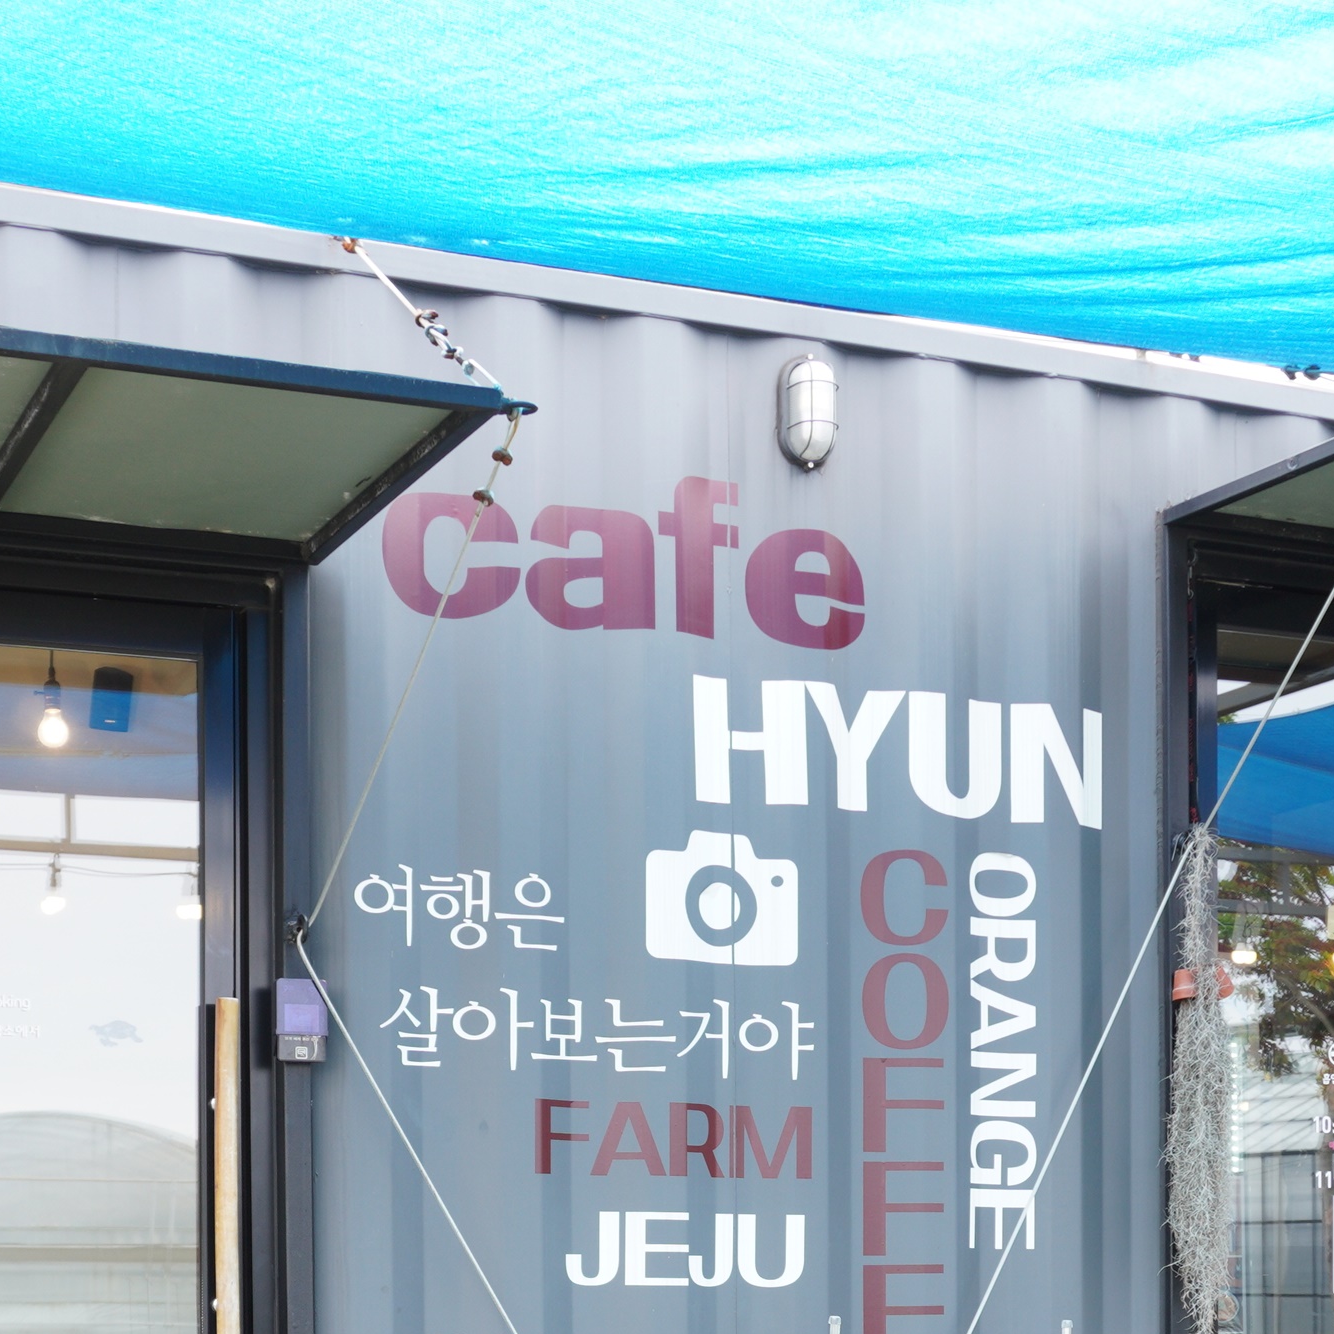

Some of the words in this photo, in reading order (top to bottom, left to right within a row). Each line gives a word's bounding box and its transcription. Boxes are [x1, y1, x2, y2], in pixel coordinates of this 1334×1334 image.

[381, 476, 866, 650] cafe
[693, 674, 1103, 830] HYUN
[353, 864, 565, 951] 여행은
[379, 985, 815, 1081] 살아보는거야
[969, 851, 1037, 1251] ORANGE
[533, 1097, 814, 1180] FARM
[565, 1211, 805, 1288] JEJU
